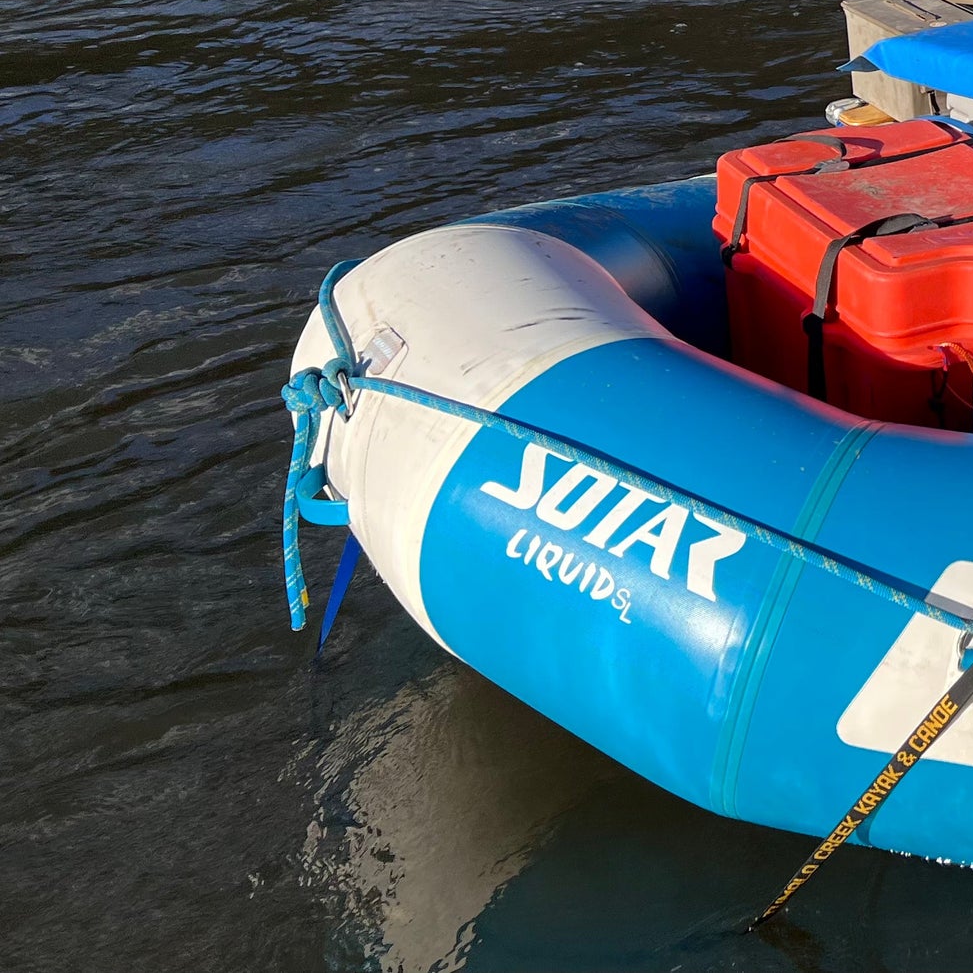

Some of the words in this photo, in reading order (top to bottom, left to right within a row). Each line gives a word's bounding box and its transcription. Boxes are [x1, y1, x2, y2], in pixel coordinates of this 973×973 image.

[479, 442, 747, 603] SOTAR
[506, 529, 616, 601] LIQUID
[813, 815, 862, 861] CREEK
[854, 764, 904, 815] KAYAK
[896, 751, 918, 767] &
[908, 694, 959, 753] CANOE
